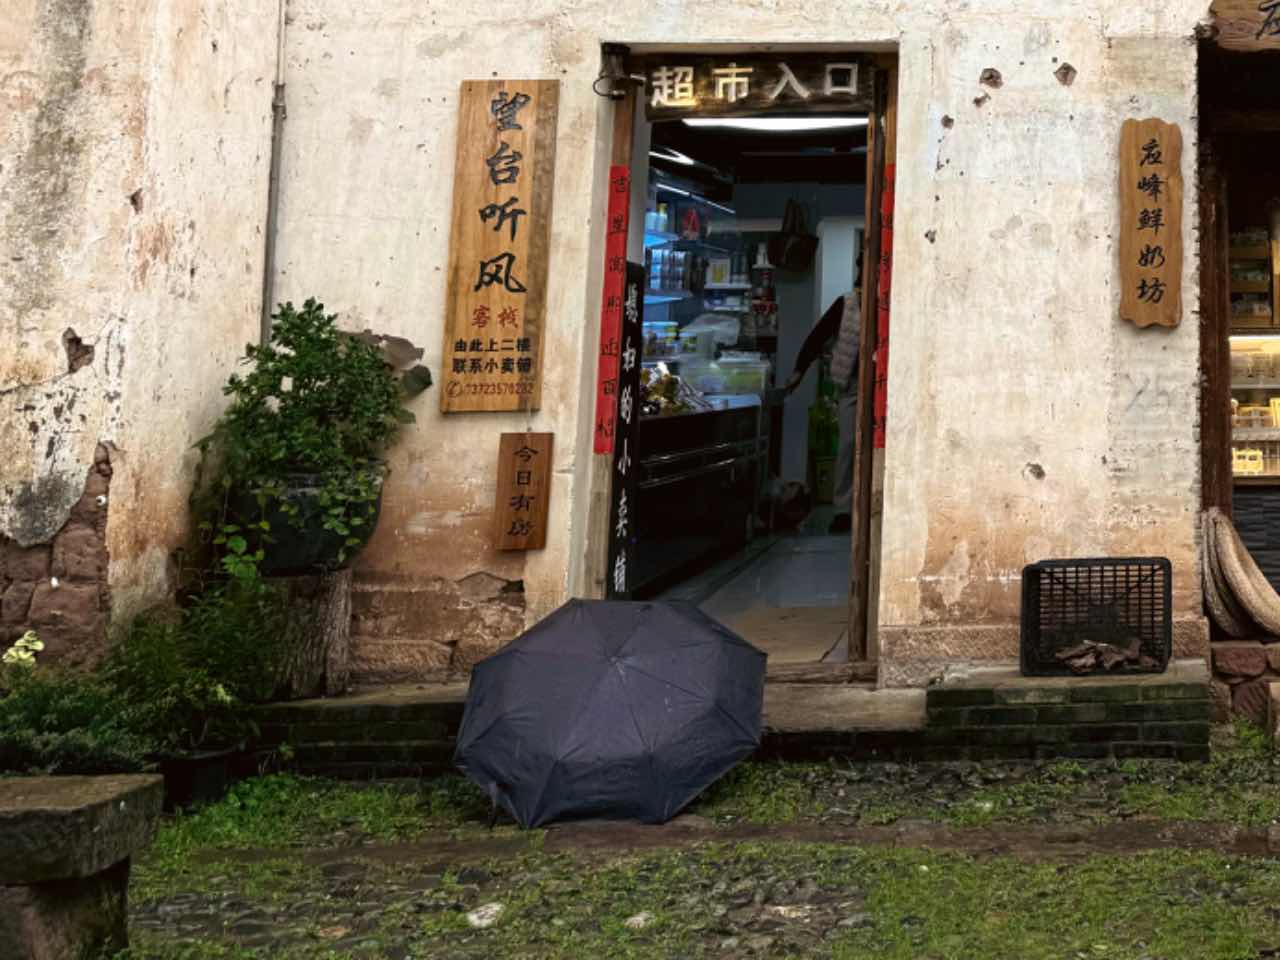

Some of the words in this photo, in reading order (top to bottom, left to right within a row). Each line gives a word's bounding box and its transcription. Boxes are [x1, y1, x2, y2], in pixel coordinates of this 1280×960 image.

[651, 61, 859, 108] 超市入口
[474, 91, 532, 294] 望台听风
[1136, 139, 1167, 305] 应峰鲜奶坊
[471, 304, 519, 329] 客栈
